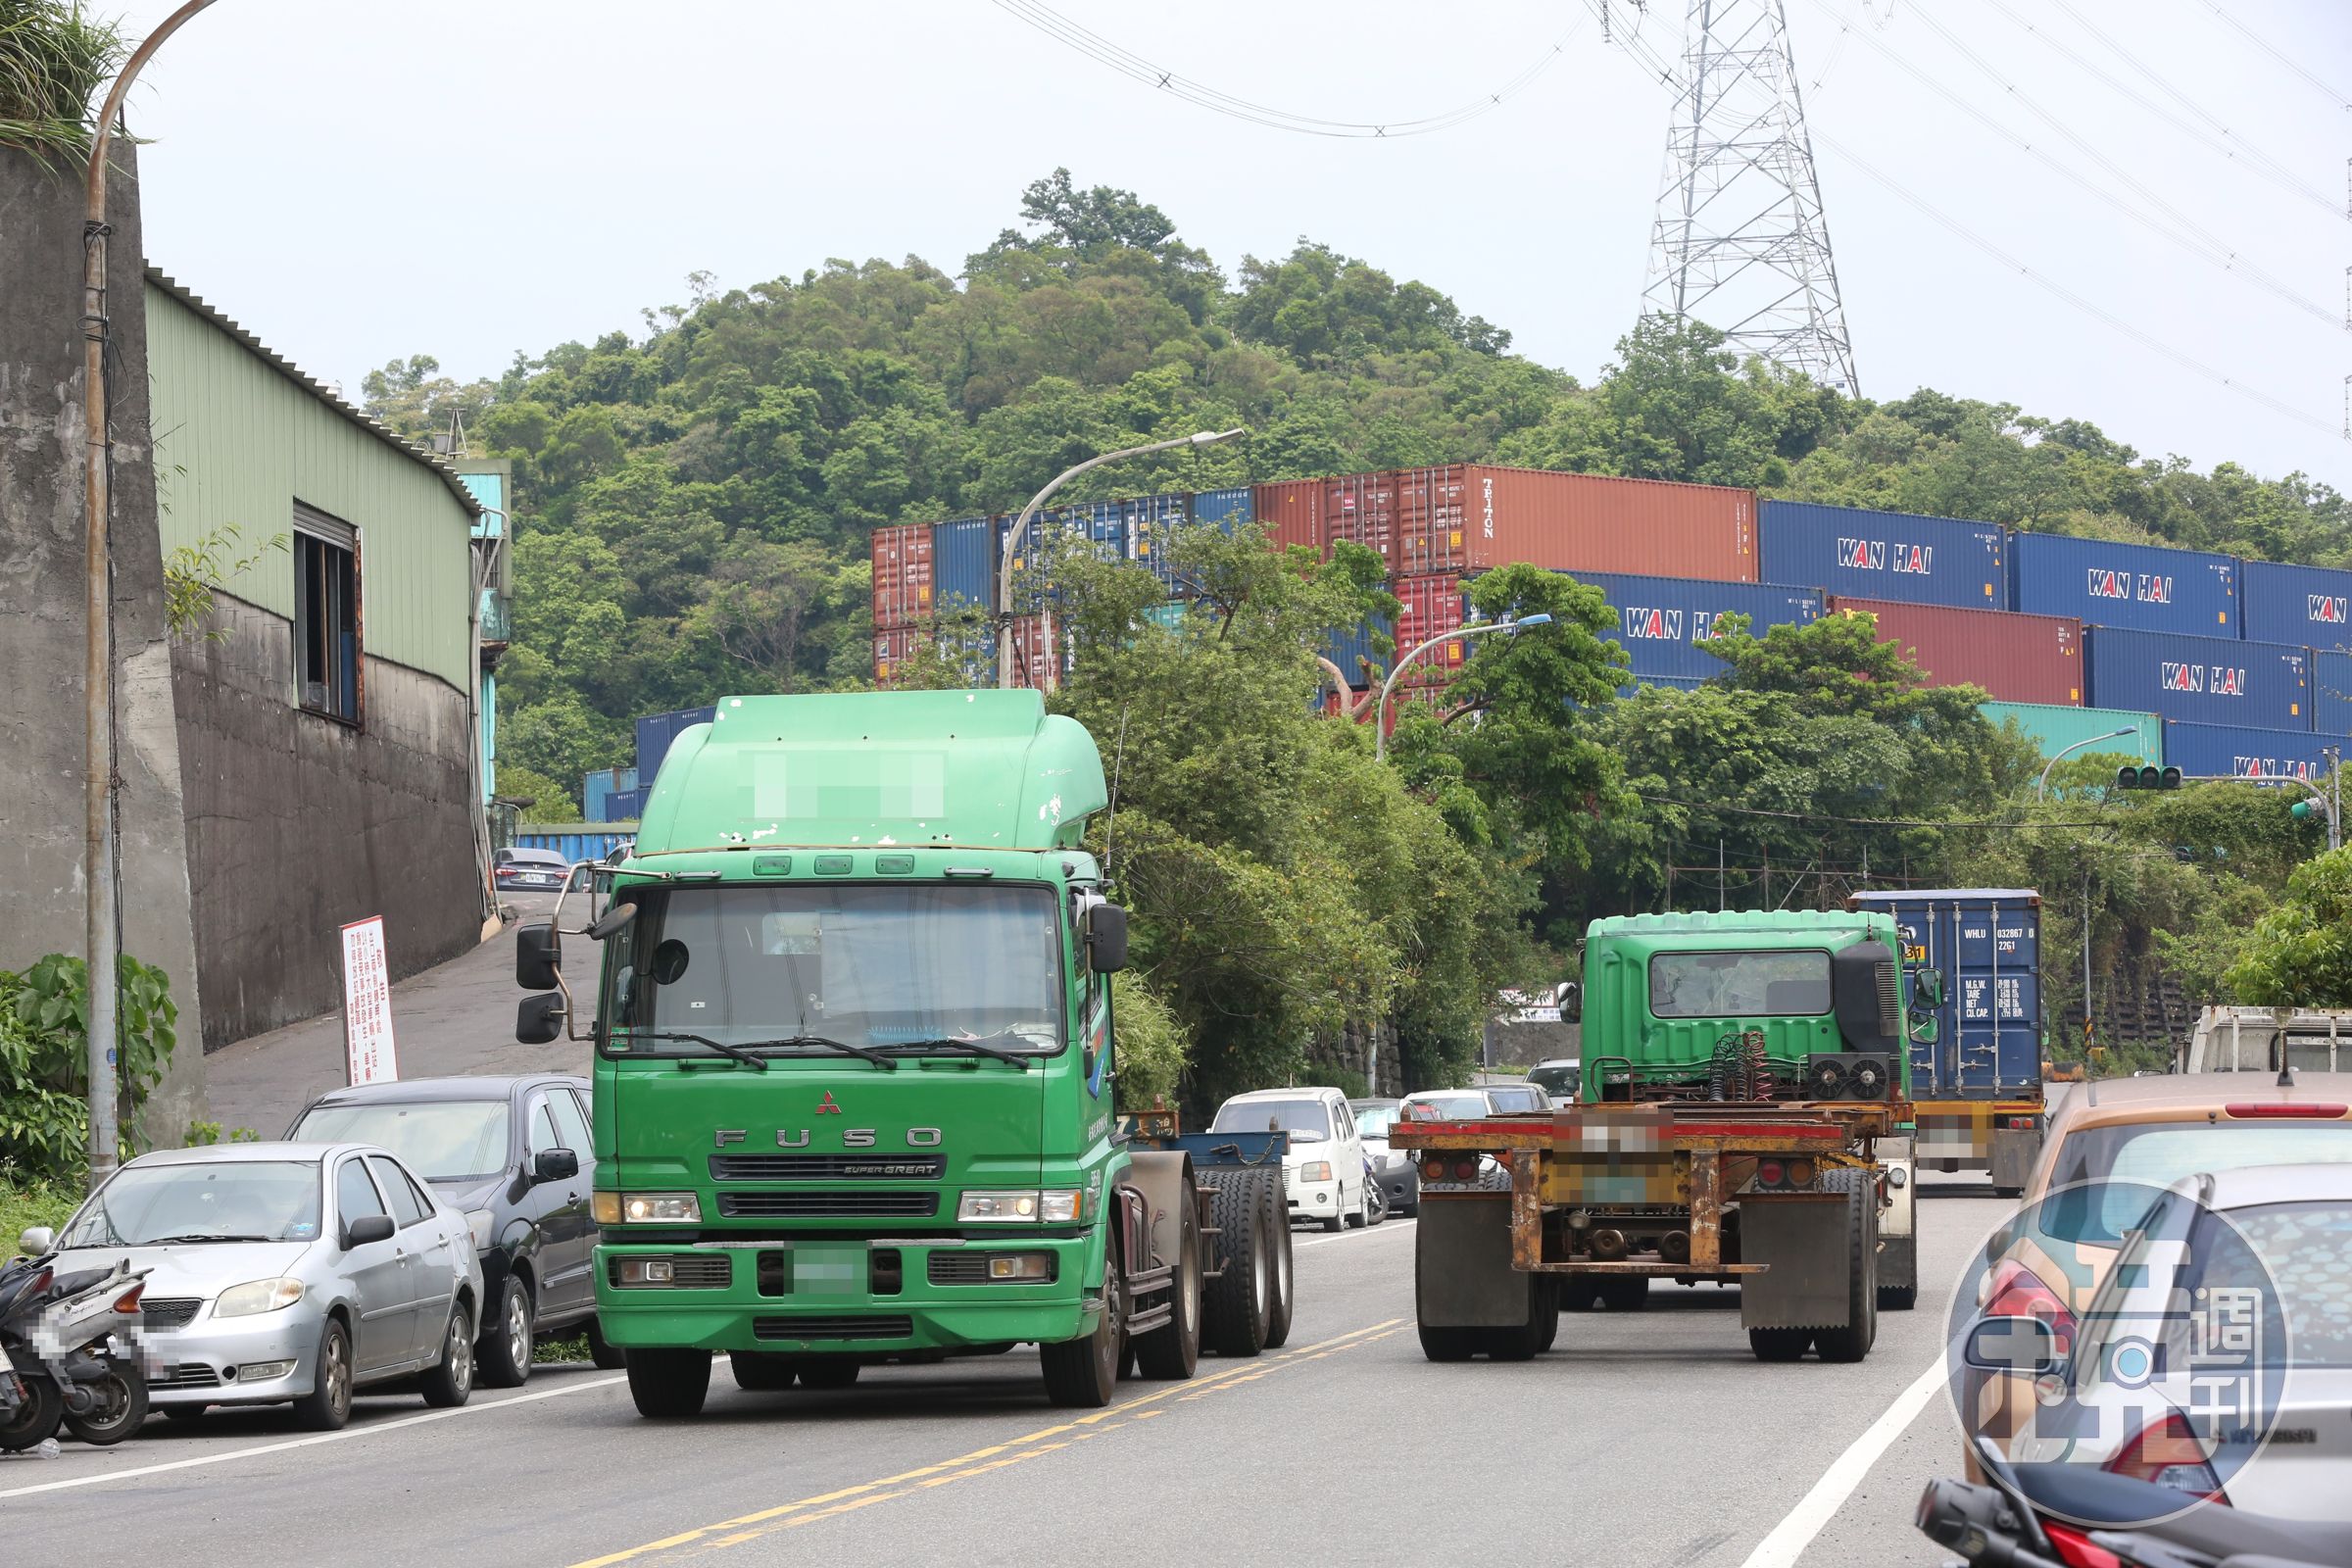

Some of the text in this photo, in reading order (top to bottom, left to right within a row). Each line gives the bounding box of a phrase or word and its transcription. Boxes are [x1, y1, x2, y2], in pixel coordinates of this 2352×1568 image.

[1483, 478, 1494, 538] TRITON
[1838, 537, 1933, 575] WAN HAI
[2087, 568, 2173, 604] WAN HAI
[2308, 594, 2347, 623] WAN
[1626, 608, 1683, 640] WAN
[2162, 662, 2246, 697] WAN HAI
[2233, 756, 2317, 787] WAN HAI
[1965, 929, 1986, 939] WHLU
[1997, 928, 2023, 938] 032867
[1998, 941, 2015, 951] 22G1
[1965, 980, 1986, 990] M.G.W.
[1966, 989, 1981, 999] TARE
[1966, 999, 1978, 1008] NET
[714, 1127, 942, 1148] FUSO
[844, 1165, 938, 1174] SUPER GREAT
